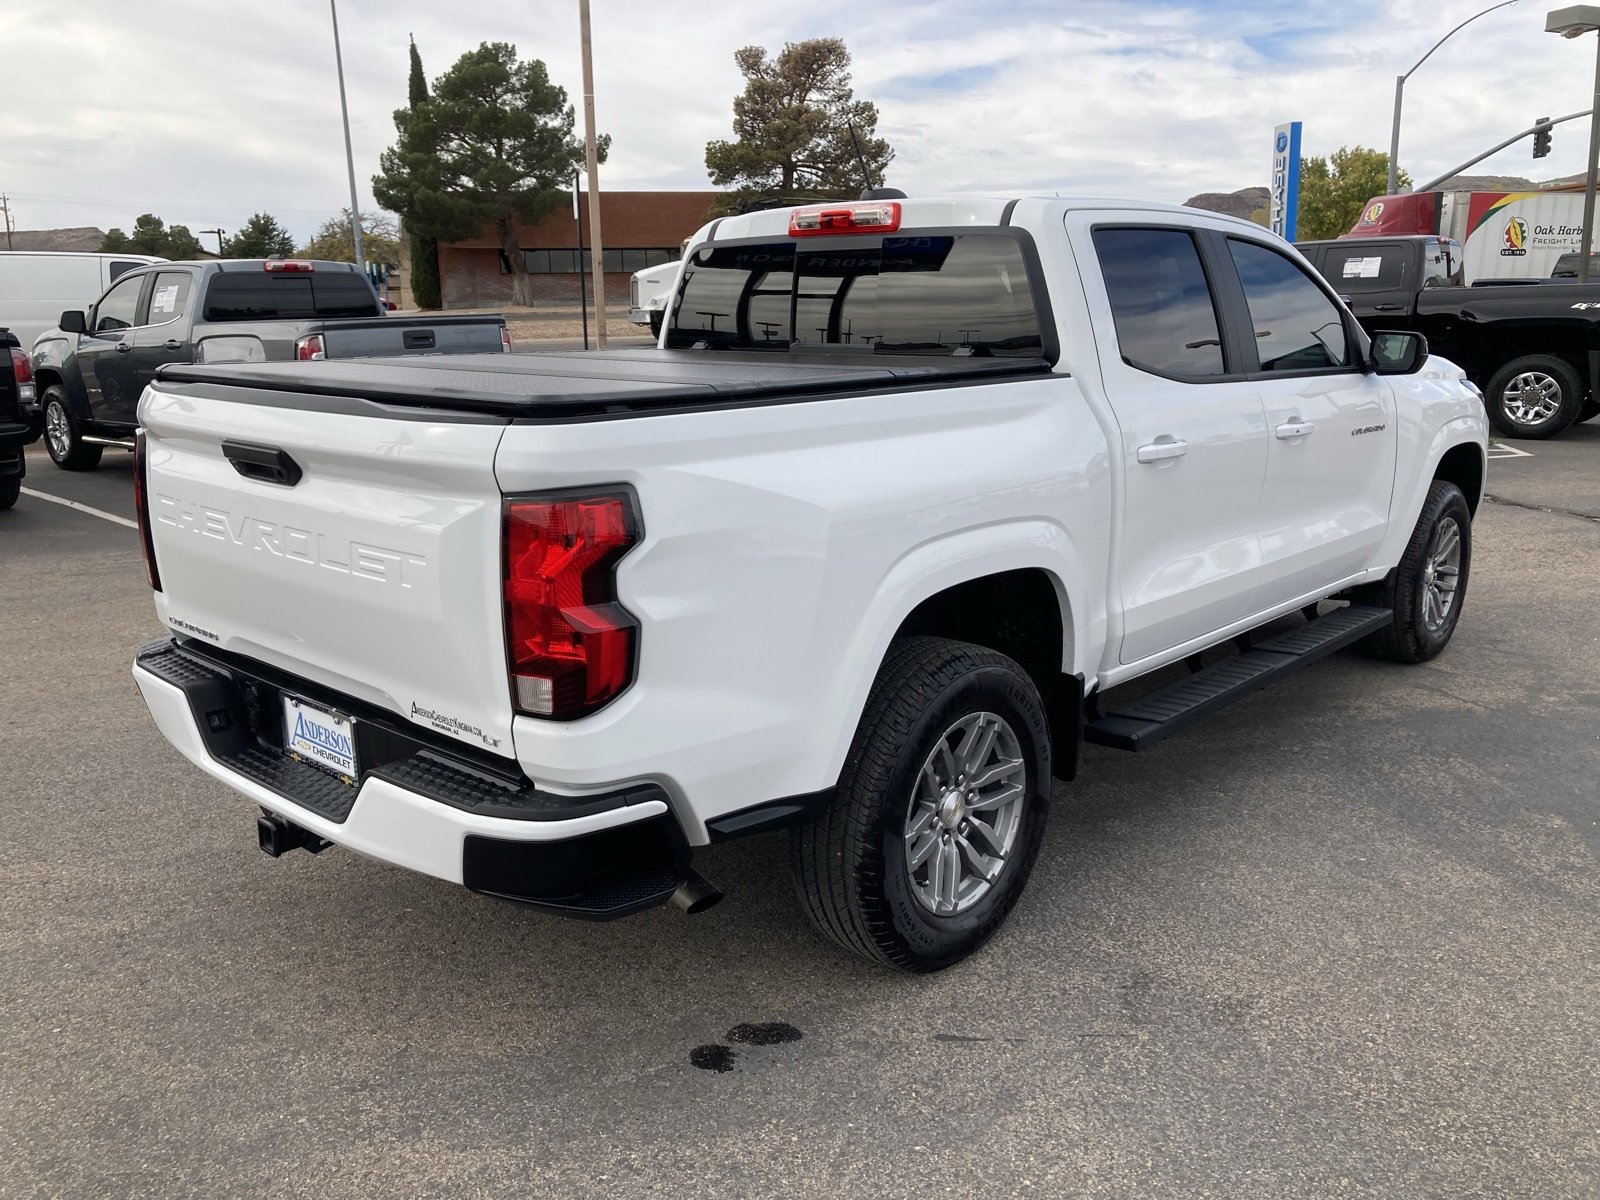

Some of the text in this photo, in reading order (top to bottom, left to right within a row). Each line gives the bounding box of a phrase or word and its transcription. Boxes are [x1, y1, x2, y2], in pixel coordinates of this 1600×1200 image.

[1272, 156, 1286, 237] CHASE
[1534, 225, 1583, 235] Oak Harb
[156, 493, 427, 589] CHEVROLET
[291, 711, 353, 756] ANDERSON
[482, 735, 501, 748] LT
[312, 746, 351, 770] CHEVROLET
